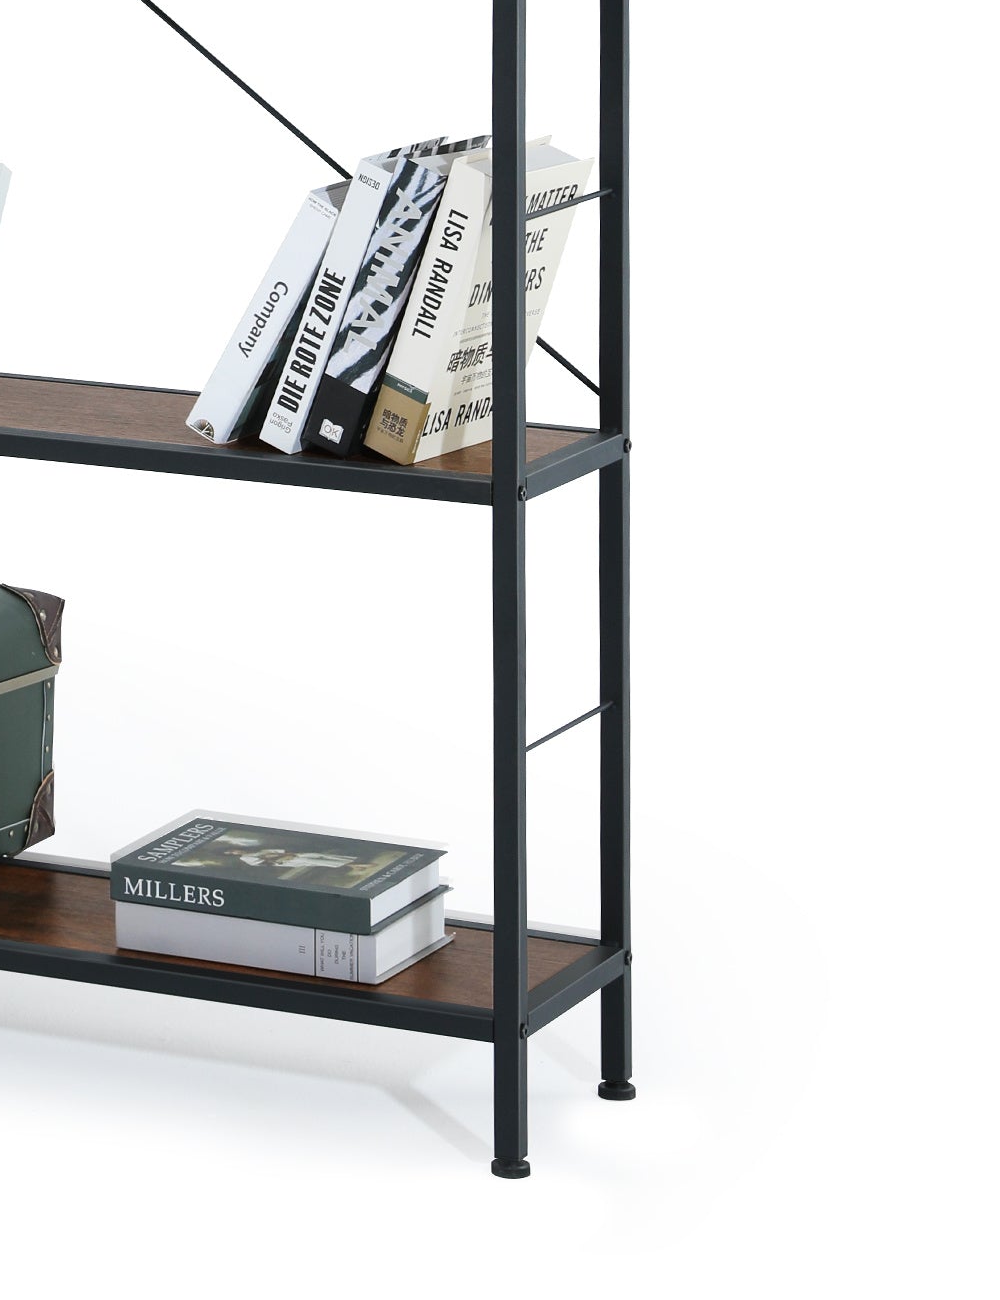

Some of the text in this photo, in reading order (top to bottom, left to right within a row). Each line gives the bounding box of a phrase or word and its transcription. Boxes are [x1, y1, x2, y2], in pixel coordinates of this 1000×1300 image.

[357, 173, 381, 190] DESIGN
[527, 184, 578, 215] MATTER
[343, 187, 423, 354] ANIMAL
[411, 208, 469, 339] LISA RANDALL
[240, 280, 288, 360] Company
[276, 267, 347, 414] DIE ROTE ZONE
[380, 418, 406, 438] 与恐龙
[382, 408, 408, 429] 暗物质
[421, 408, 452, 438] LISA
[454, 396, 492, 427] RAND
[137, 823, 214, 862] SAMPLERS
[123, 876, 225, 908] MILLERS
